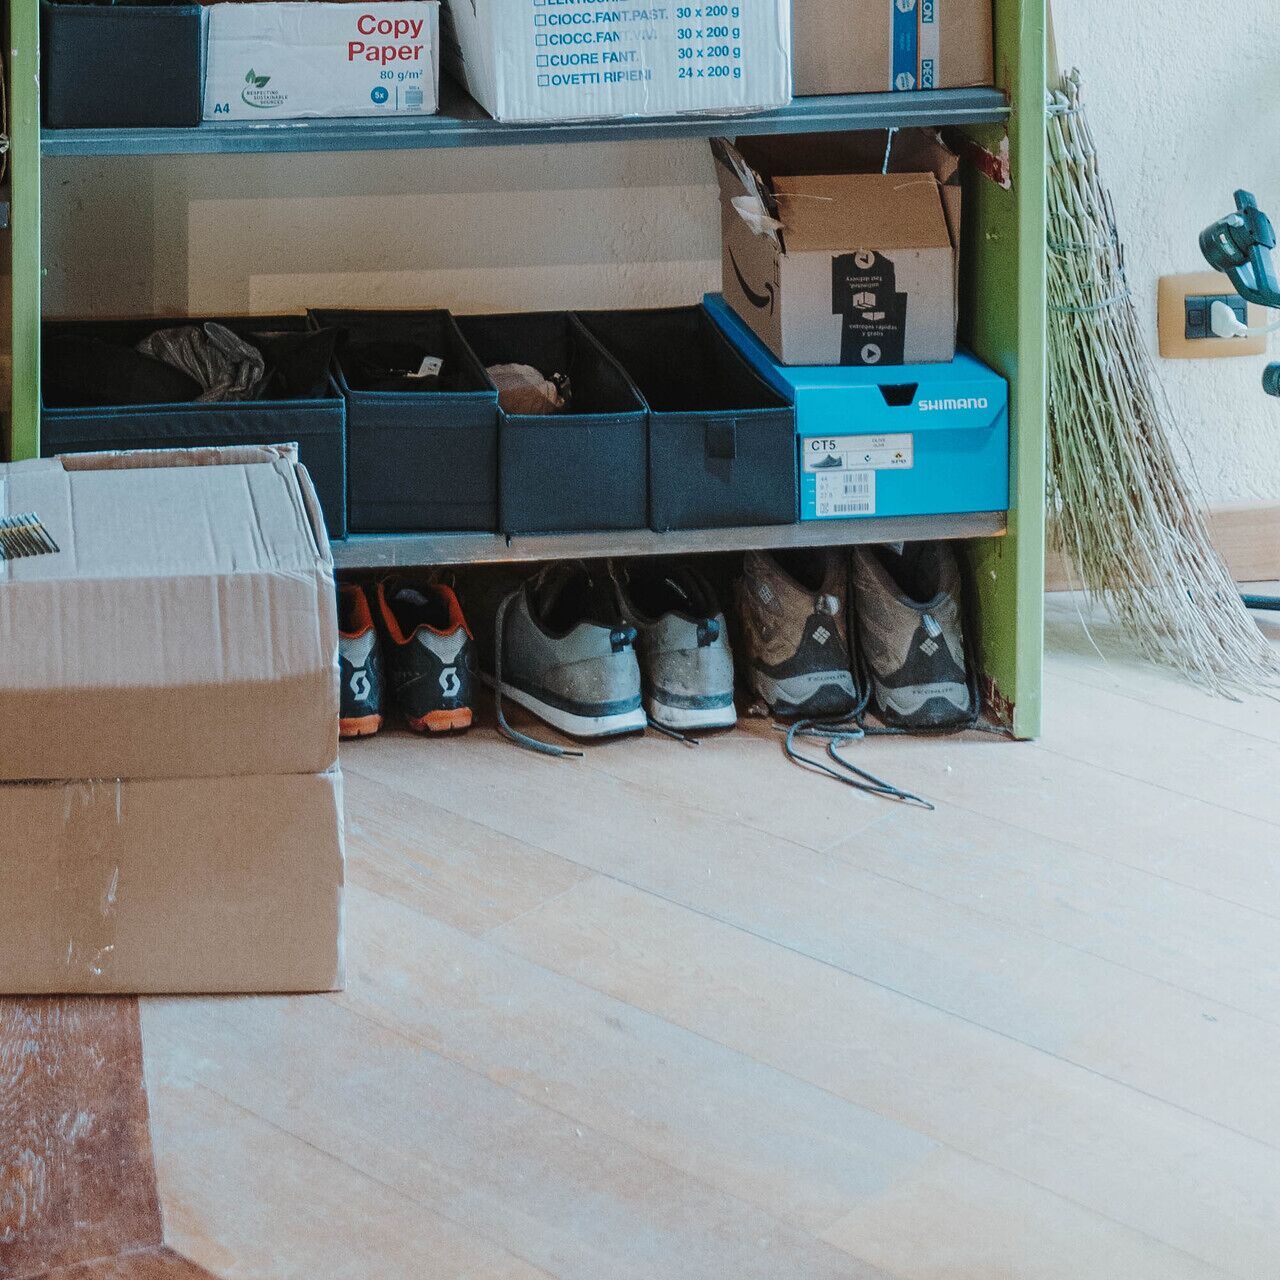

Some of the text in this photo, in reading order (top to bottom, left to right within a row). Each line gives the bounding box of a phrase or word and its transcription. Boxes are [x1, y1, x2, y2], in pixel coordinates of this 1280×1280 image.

[548, 5, 739, 26] CIOCC.FANT.PAST. 30 x 200 g
[357, 14, 423, 38] Copy
[677, 28, 692, 39] 30
[696, 30, 702, 38] x
[706, 26, 729, 38] 200
[732, 27, 740, 39] g
[348, 41, 423, 65] Paper
[550, 45, 740, 66] CUORE FANT. 30 x 200 g
[379, 70, 394, 80] 80
[552, 65, 741, 86] OVETTI RIPIENI 24 x 200 g
[374, 91, 385, 99] 5x
[214, 104, 230, 113] A4
[918, 397, 988, 411] SHIMANO
[811, 439, 836, 451] CT5
